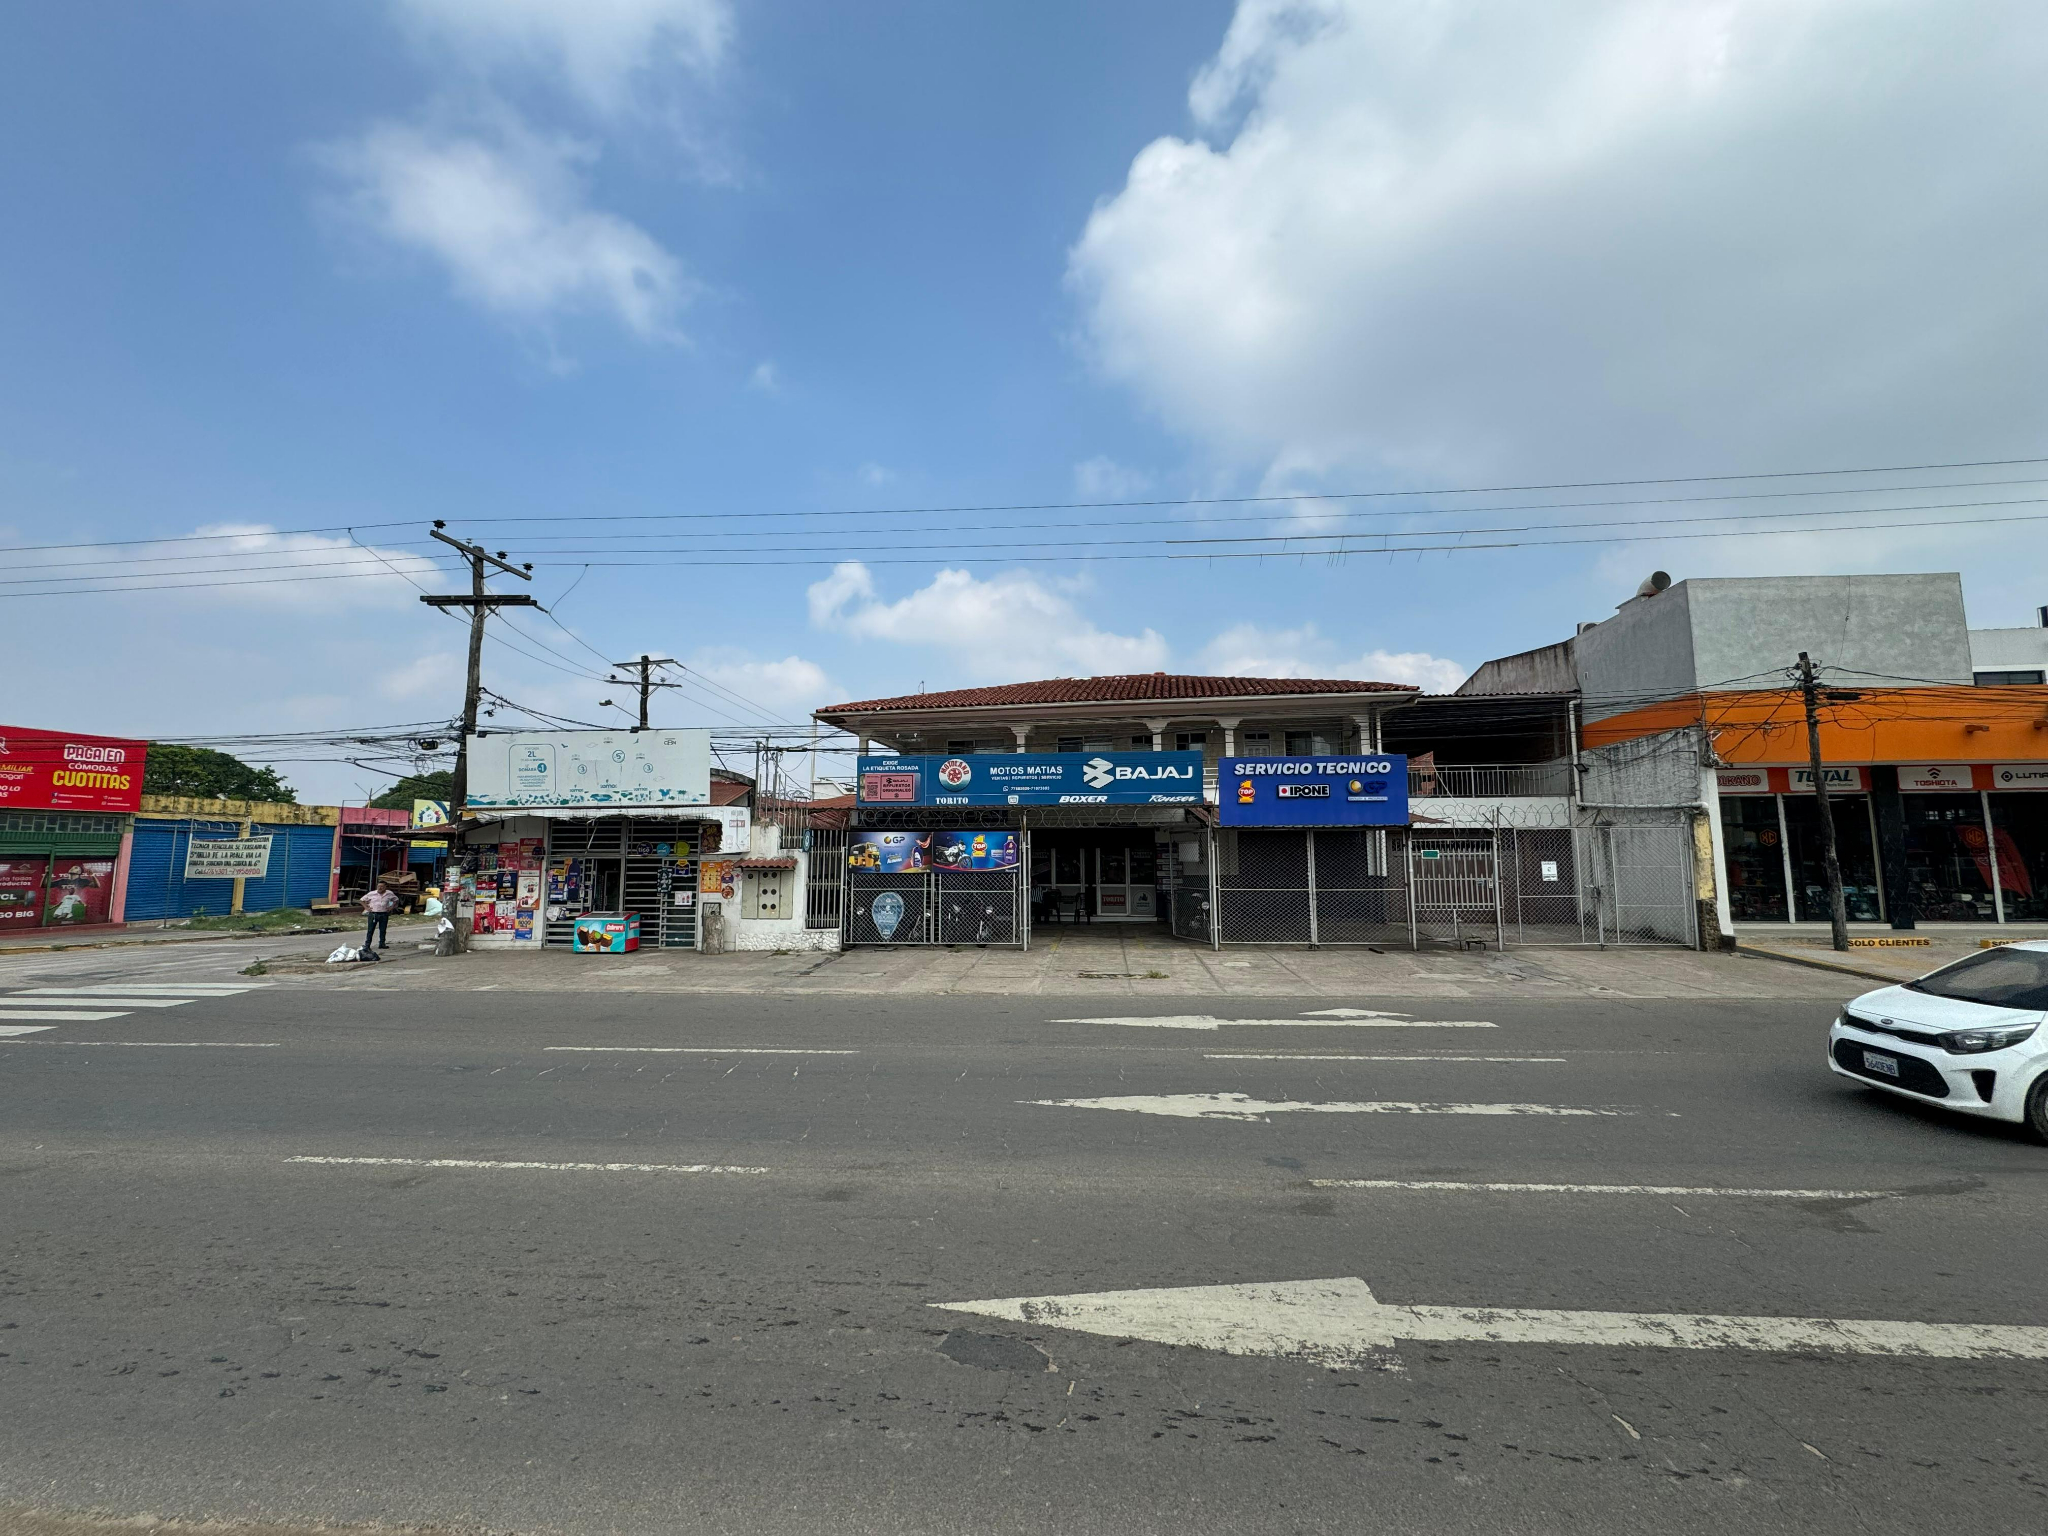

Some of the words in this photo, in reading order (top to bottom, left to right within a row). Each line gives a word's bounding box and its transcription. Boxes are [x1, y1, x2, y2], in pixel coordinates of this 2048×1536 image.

[64, 744, 104, 762] PAGA
[69, 762, 118, 772] CÓMODAS
[941, 760, 970, 776] MOTOLAND
[991, 767, 1024, 775] MOTOS
[1028, 766, 1063, 774] MATIAS
[1116, 766, 1193, 780] BAJAJ
[1234, 763, 1313, 775] SERVICIO
[1317, 762, 1392, 774] TECNICO
[53, 770, 130, 789] CUOTITAS
[1290, 785, 1329, 796] IPONE
[1364, 781, 1388, 794] GP
[1059, 795, 1108, 803] BOXER
